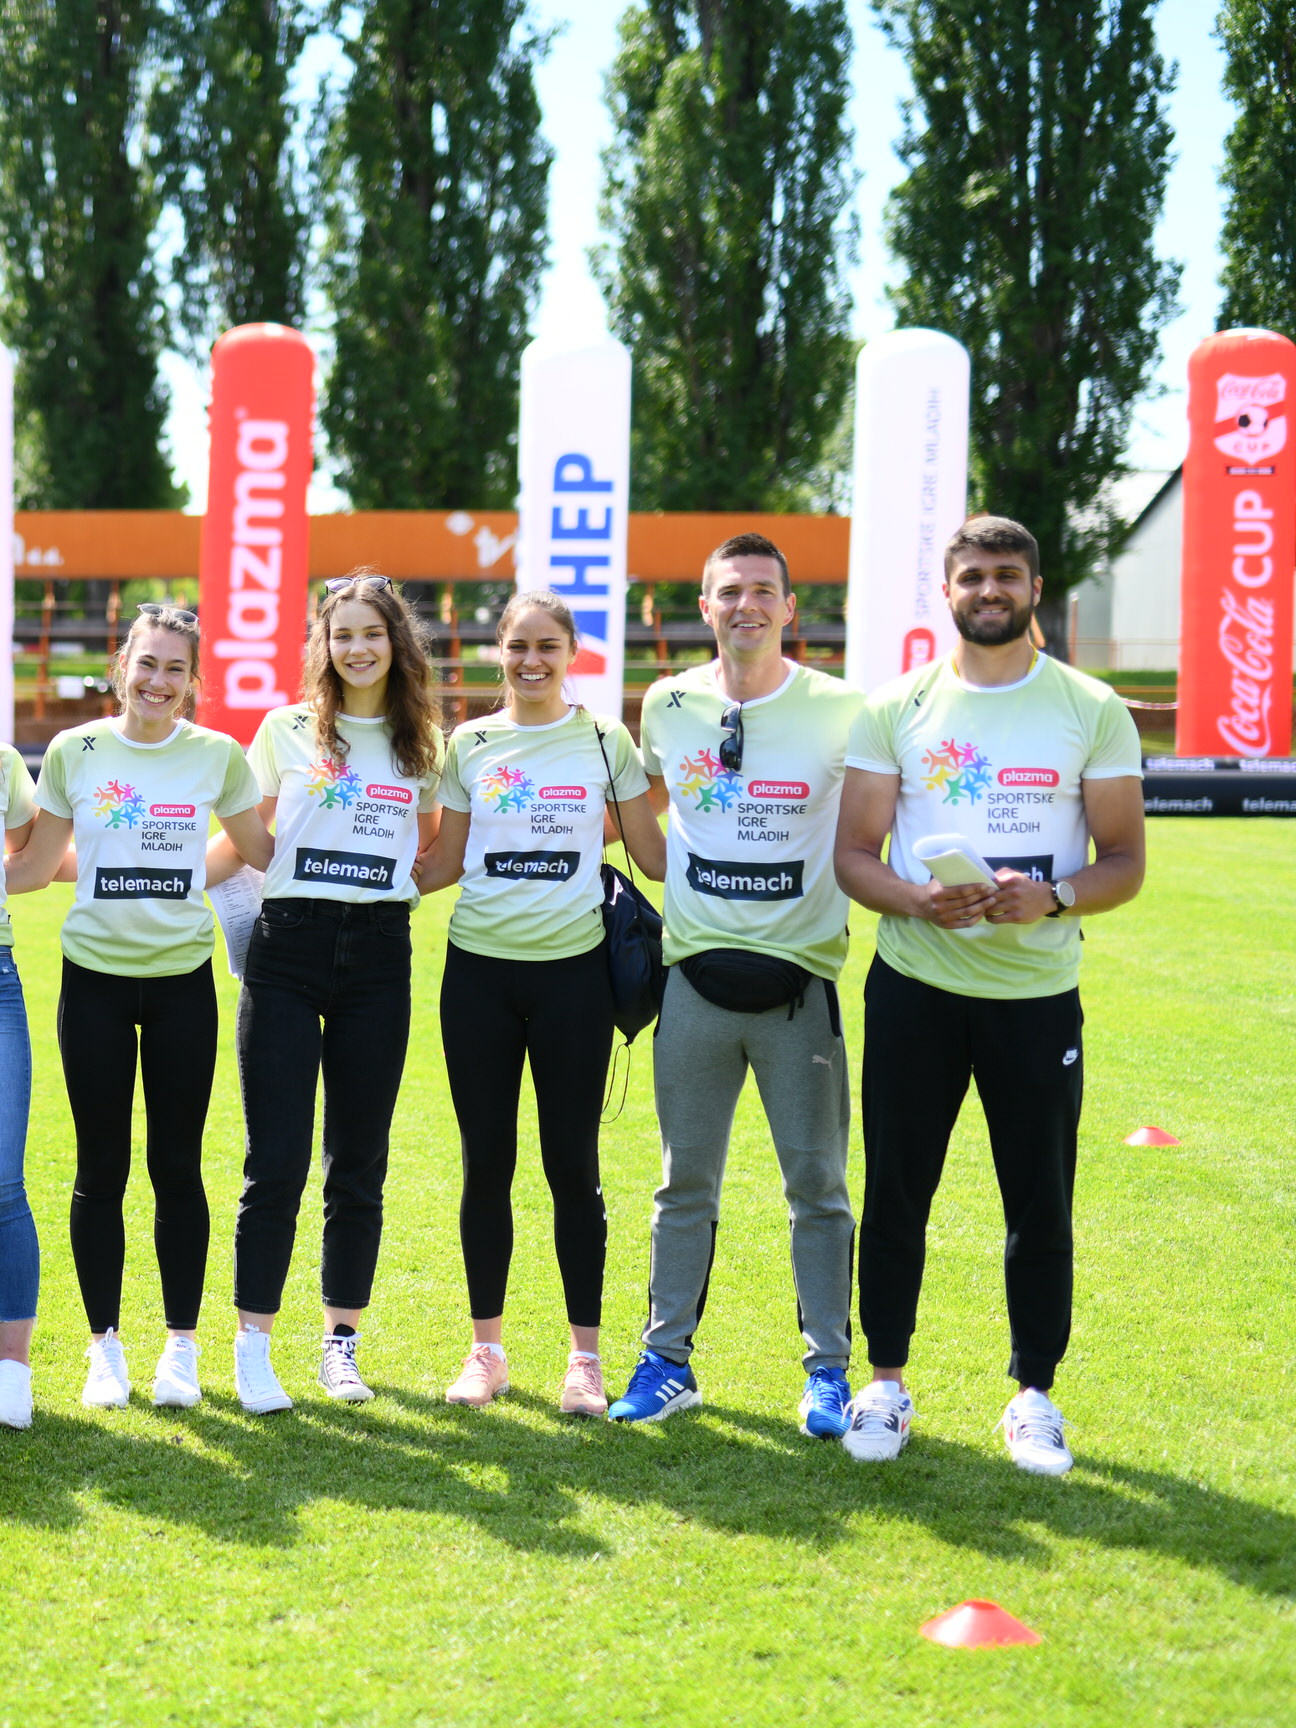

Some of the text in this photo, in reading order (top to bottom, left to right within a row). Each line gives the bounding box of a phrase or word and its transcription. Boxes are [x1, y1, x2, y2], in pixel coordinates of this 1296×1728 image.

[923, 385, 942, 466] MLADIH
[919, 473, 939, 516] IGRE
[550, 453, 613, 596] HEP
[1232, 489, 1274, 588] CUP
[213, 419, 290, 710] plazma
[915, 521, 936, 621] SPORTSKE
[1146, 757, 1216, 771] telemach
[1239, 758, 1296, 773] telemac
[1003, 770, 1053, 784] plazma
[370, 786, 409, 800] plazma
[543, 788, 582, 798] plazma
[753, 783, 803, 796] plazma
[987, 792, 1056, 804] SPORTSKE
[1144, 796, 1214, 812] elemach
[1242, 797, 1296, 812] telema
[153, 805, 191, 815] plazma
[356, 801, 409, 818] SPORTSKE
[530, 803, 587, 814] SPORTSKE
[737, 803, 808, 815] SPORTSKE
[987, 807, 1019, 819] IGRE
[142, 820, 197, 831] SPORTSKE
[354, 813, 380, 825] IGRE
[530, 814, 556, 823] IGRE
[737, 816, 768, 828] IGRE
[352, 825, 395, 840] MLADIH
[531, 825, 573, 835] MLADIH
[987, 822, 1040, 834] MLADIH
[141, 831, 166, 840] IGRE
[737, 830, 789, 842] MLADIH
[141, 842, 183, 852] MLADIH
[304, 858, 388, 882] telemach
[100, 876, 184, 893] telemach
[695, 866, 793, 891] telemach
